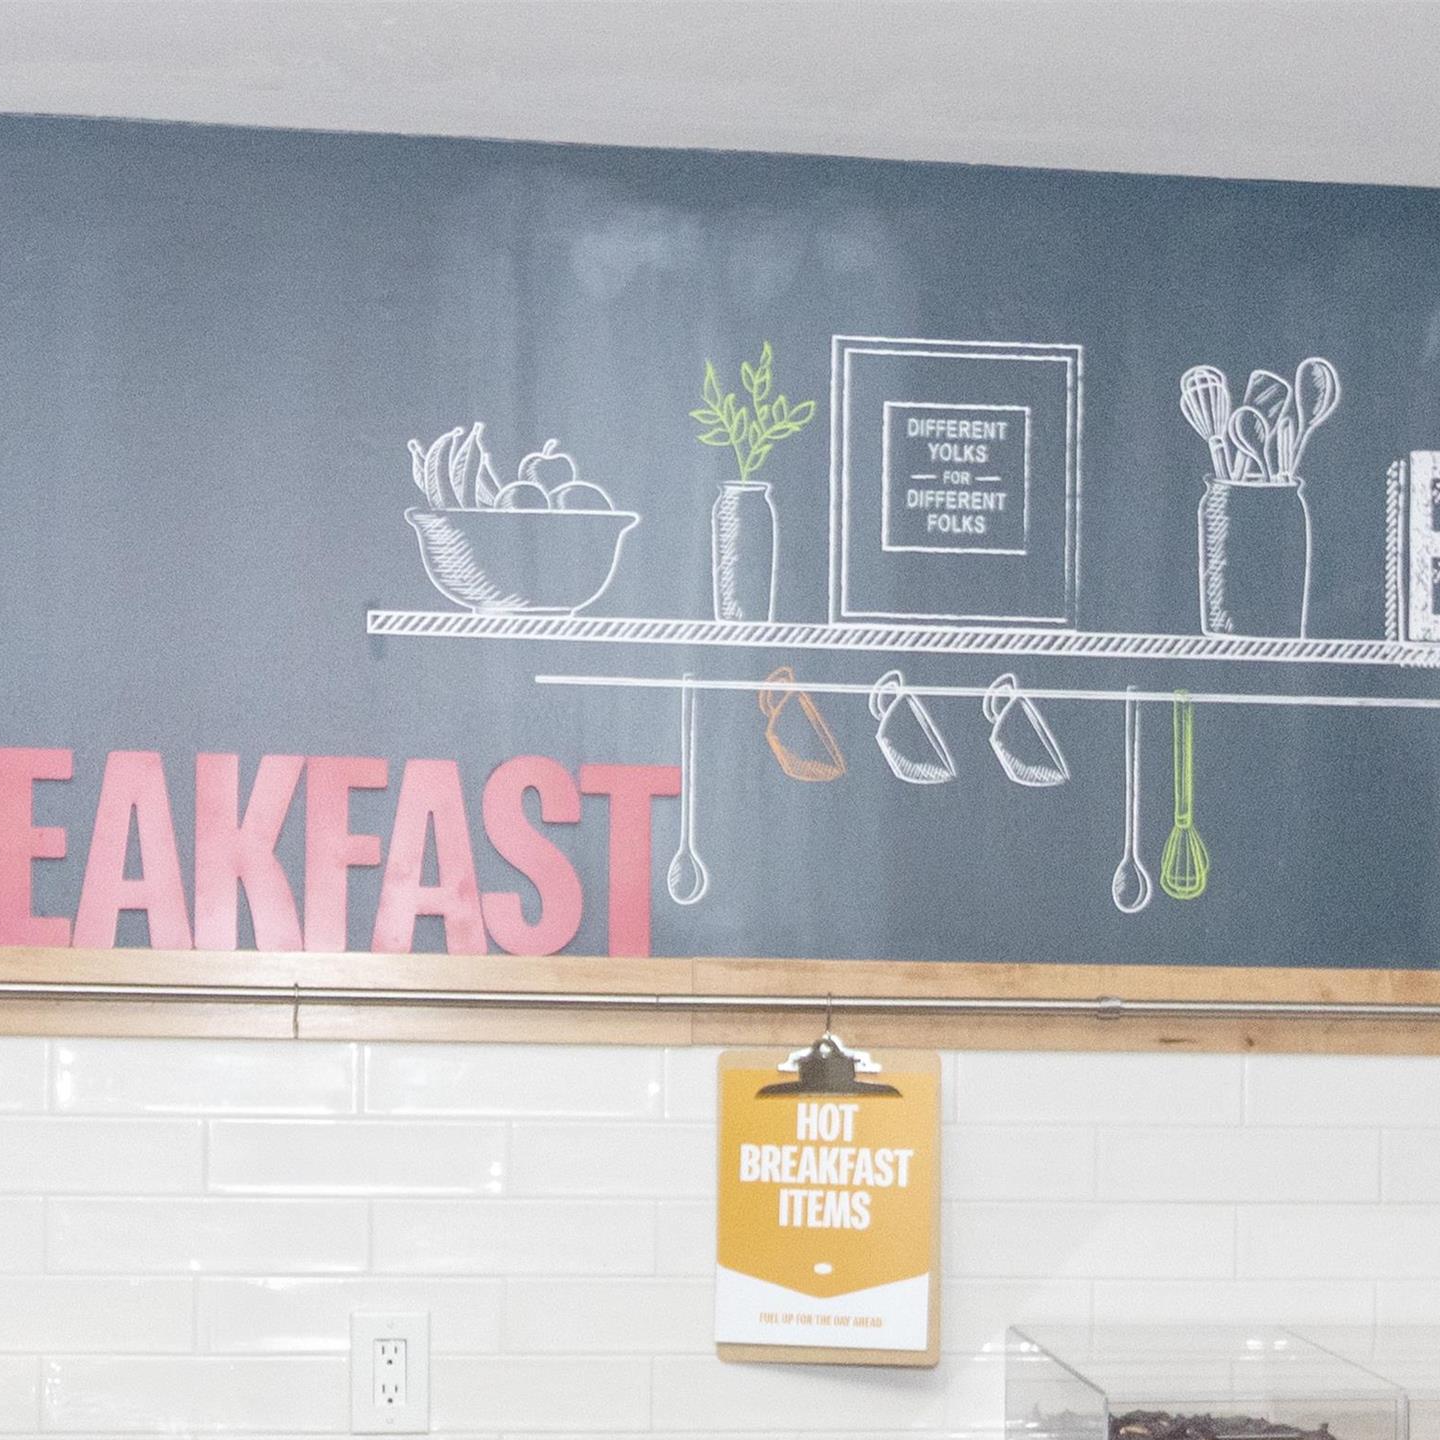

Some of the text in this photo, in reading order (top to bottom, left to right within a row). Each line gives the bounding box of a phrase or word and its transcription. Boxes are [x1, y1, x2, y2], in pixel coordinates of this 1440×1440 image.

[907, 417, 1008, 440] DIFFERENT
[928, 442, 989, 464] YOLKS
[942, 471, 971, 485] FOR
[906, 488, 1006, 511] DIFFERENT
[927, 514, 986, 534] FOLKS
[796, 1102, 857, 1142] HOT
[739, 1144, 914, 1187] BREAKFAST
[778, 1188, 871, 1230] ITEMS
[759, 1312, 778, 1324] FUEL
[781, 1312, 794, 1325] UP
[796, 1313, 812, 1326] FOR
[815, 1314, 832, 1327] THE
[833, 1315, 849, 1327] DAY
